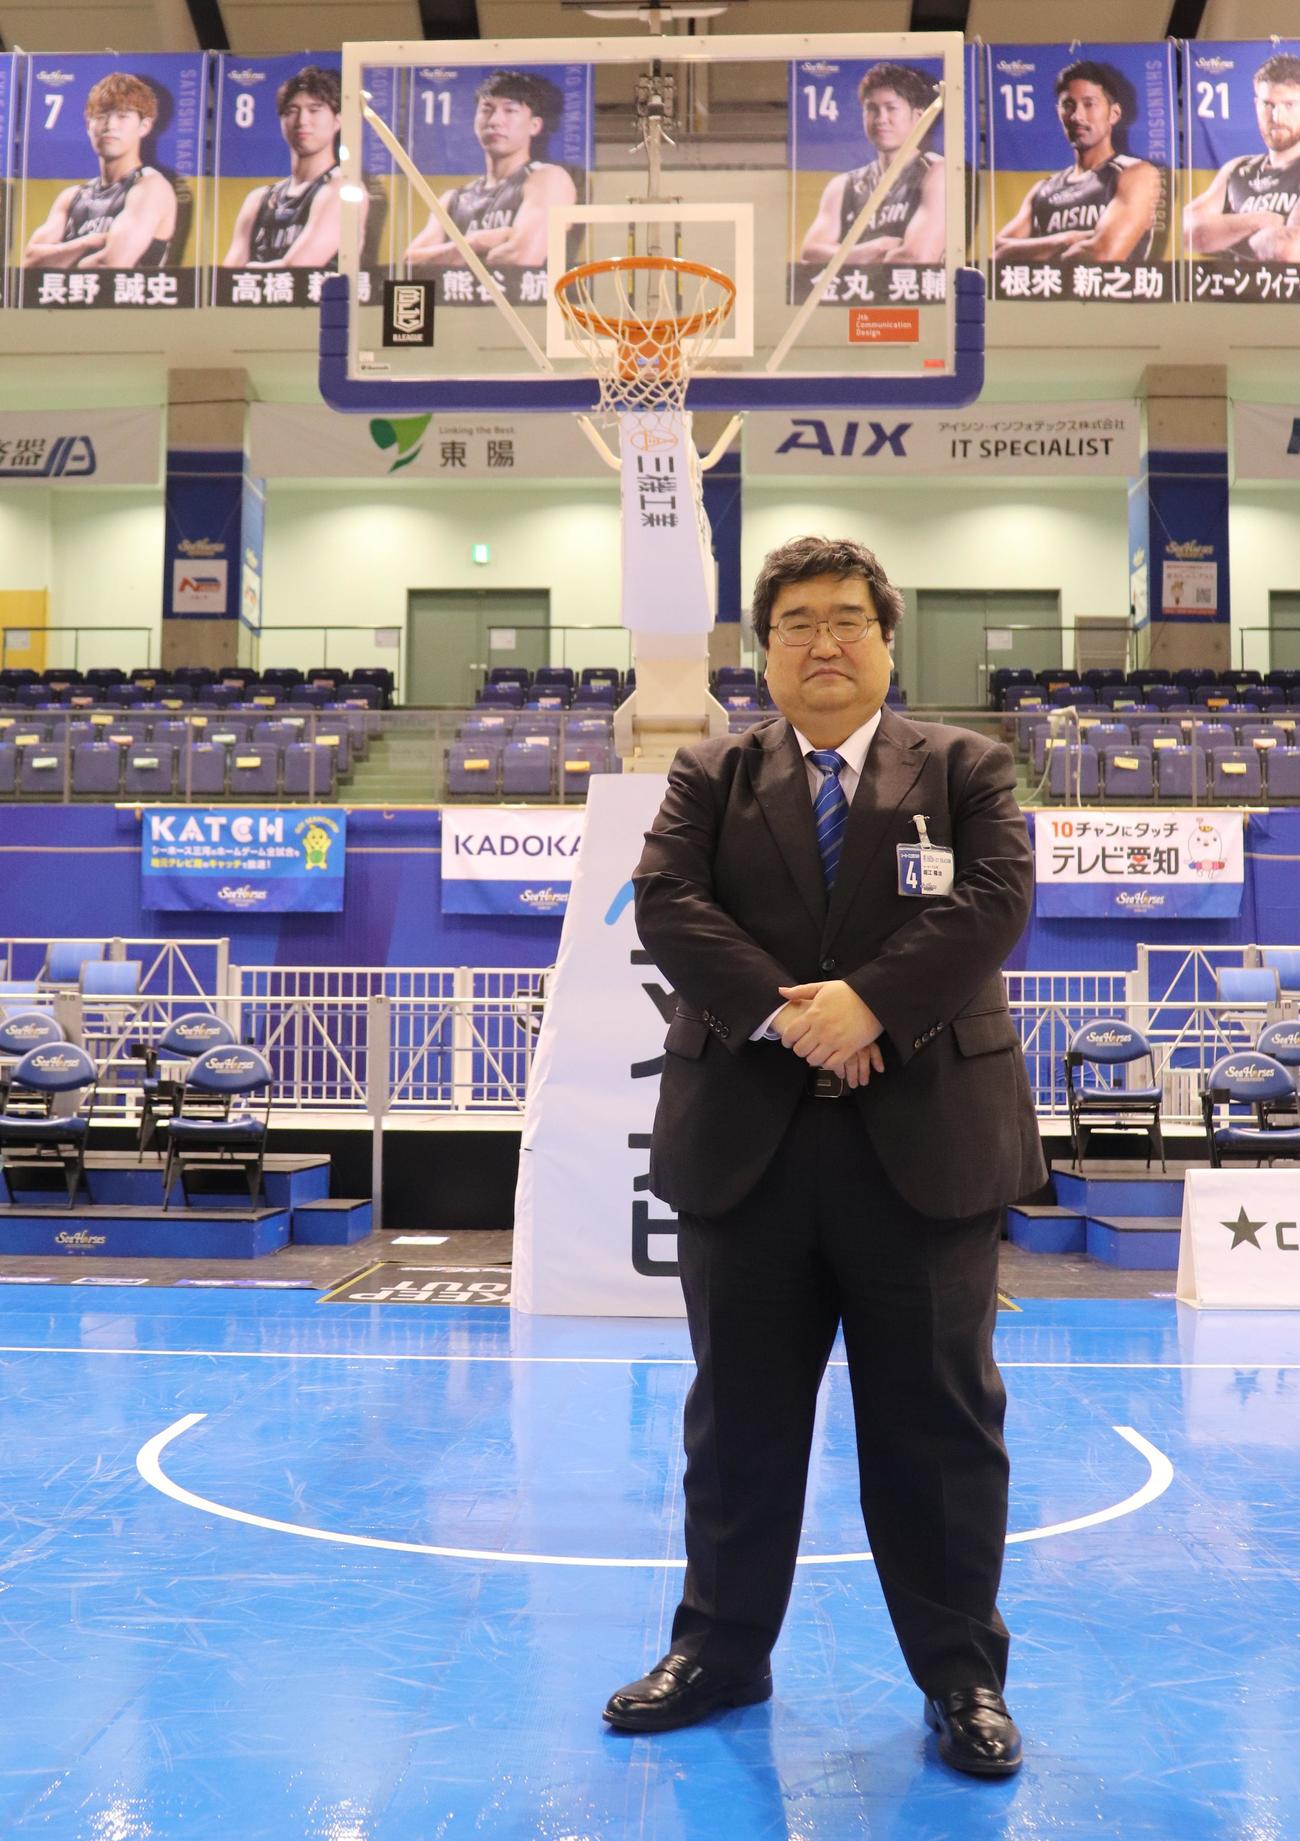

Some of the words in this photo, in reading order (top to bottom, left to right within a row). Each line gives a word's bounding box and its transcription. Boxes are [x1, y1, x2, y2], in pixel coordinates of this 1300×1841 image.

[44, 94, 64, 129] 7
[234, 93, 256, 128] 8
[420, 90, 451, 125] 11
[803, 85, 840, 122] 14
[1000, 84, 1034, 121] 15
[1196, 81, 1230, 119] 21
[1046, 204, 1106, 233] AISIN
[38, 273, 99, 304] 長野
[114, 273, 178, 304] 誠史
[232, 272, 294, 304] 高橋
[443, 271, 506, 301] 熊谷
[811, 270, 874, 301] 金丸
[1073, 265, 1163, 298] 新之助
[1195, 266, 1250, 296] シェーン
[439, 426, 474, 436] Linking
[477, 426, 492, 435] the
[775, 419, 913, 456] AIX
[440, 441, 515, 468] 東陽
[951, 440, 972, 458] IT
[979, 438, 1114, 457] SPECIALIST
[151, 816, 284, 843] KATCH
[1052, 821, 1179, 838] 10チャンにタッチ
[905, 861, 918, 889] 4
[1052, 846, 1180, 875] テレビ愛知
[1224, 1063, 1275, 1080] SeaHorses
[55, 1228, 107, 1245] SeaHorses
[348, 1289, 512, 1303] KEEP
[380, 1280, 508, 1292] OUT
